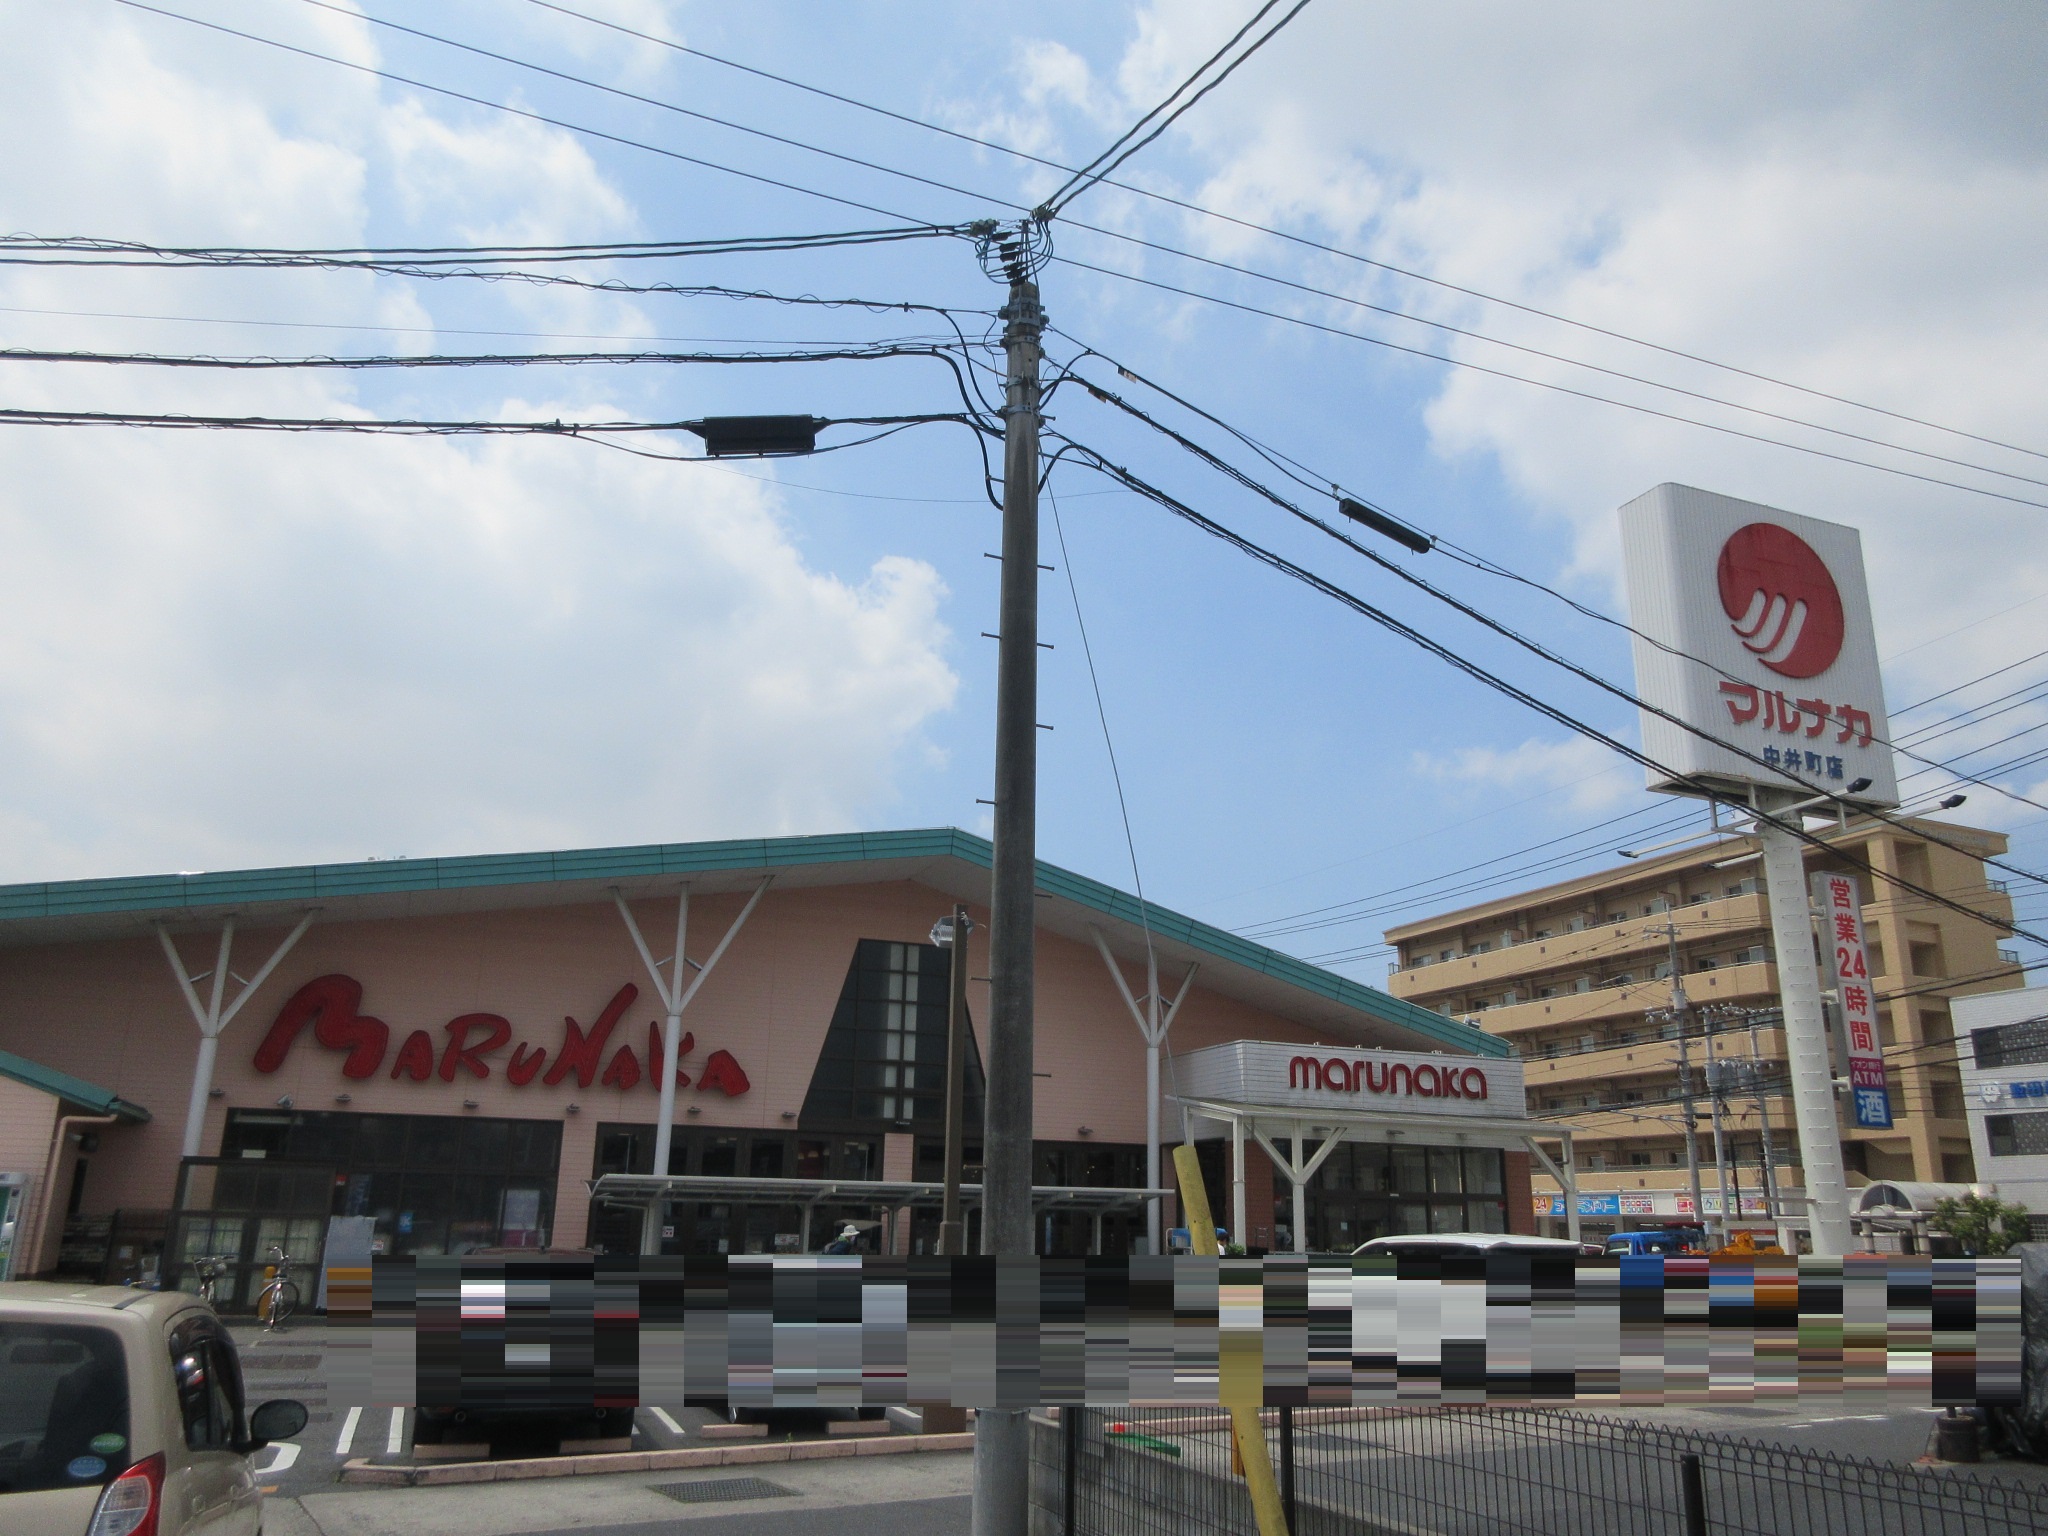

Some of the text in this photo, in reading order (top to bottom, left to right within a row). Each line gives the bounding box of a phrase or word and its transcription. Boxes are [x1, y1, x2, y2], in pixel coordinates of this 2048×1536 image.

[1718, 681, 1874, 747] マルナカ
[1763, 744, 1844, 779] 中井町店
[1830, 878, 1875, 1053] 営業24時間
[1289, 1055, 1489, 1100] marunaka
[1853, 1071, 1884, 1085] ATM
[1858, 1090, 1887, 1124] 酒
[1534, 1197, 1547, 1210] 24
